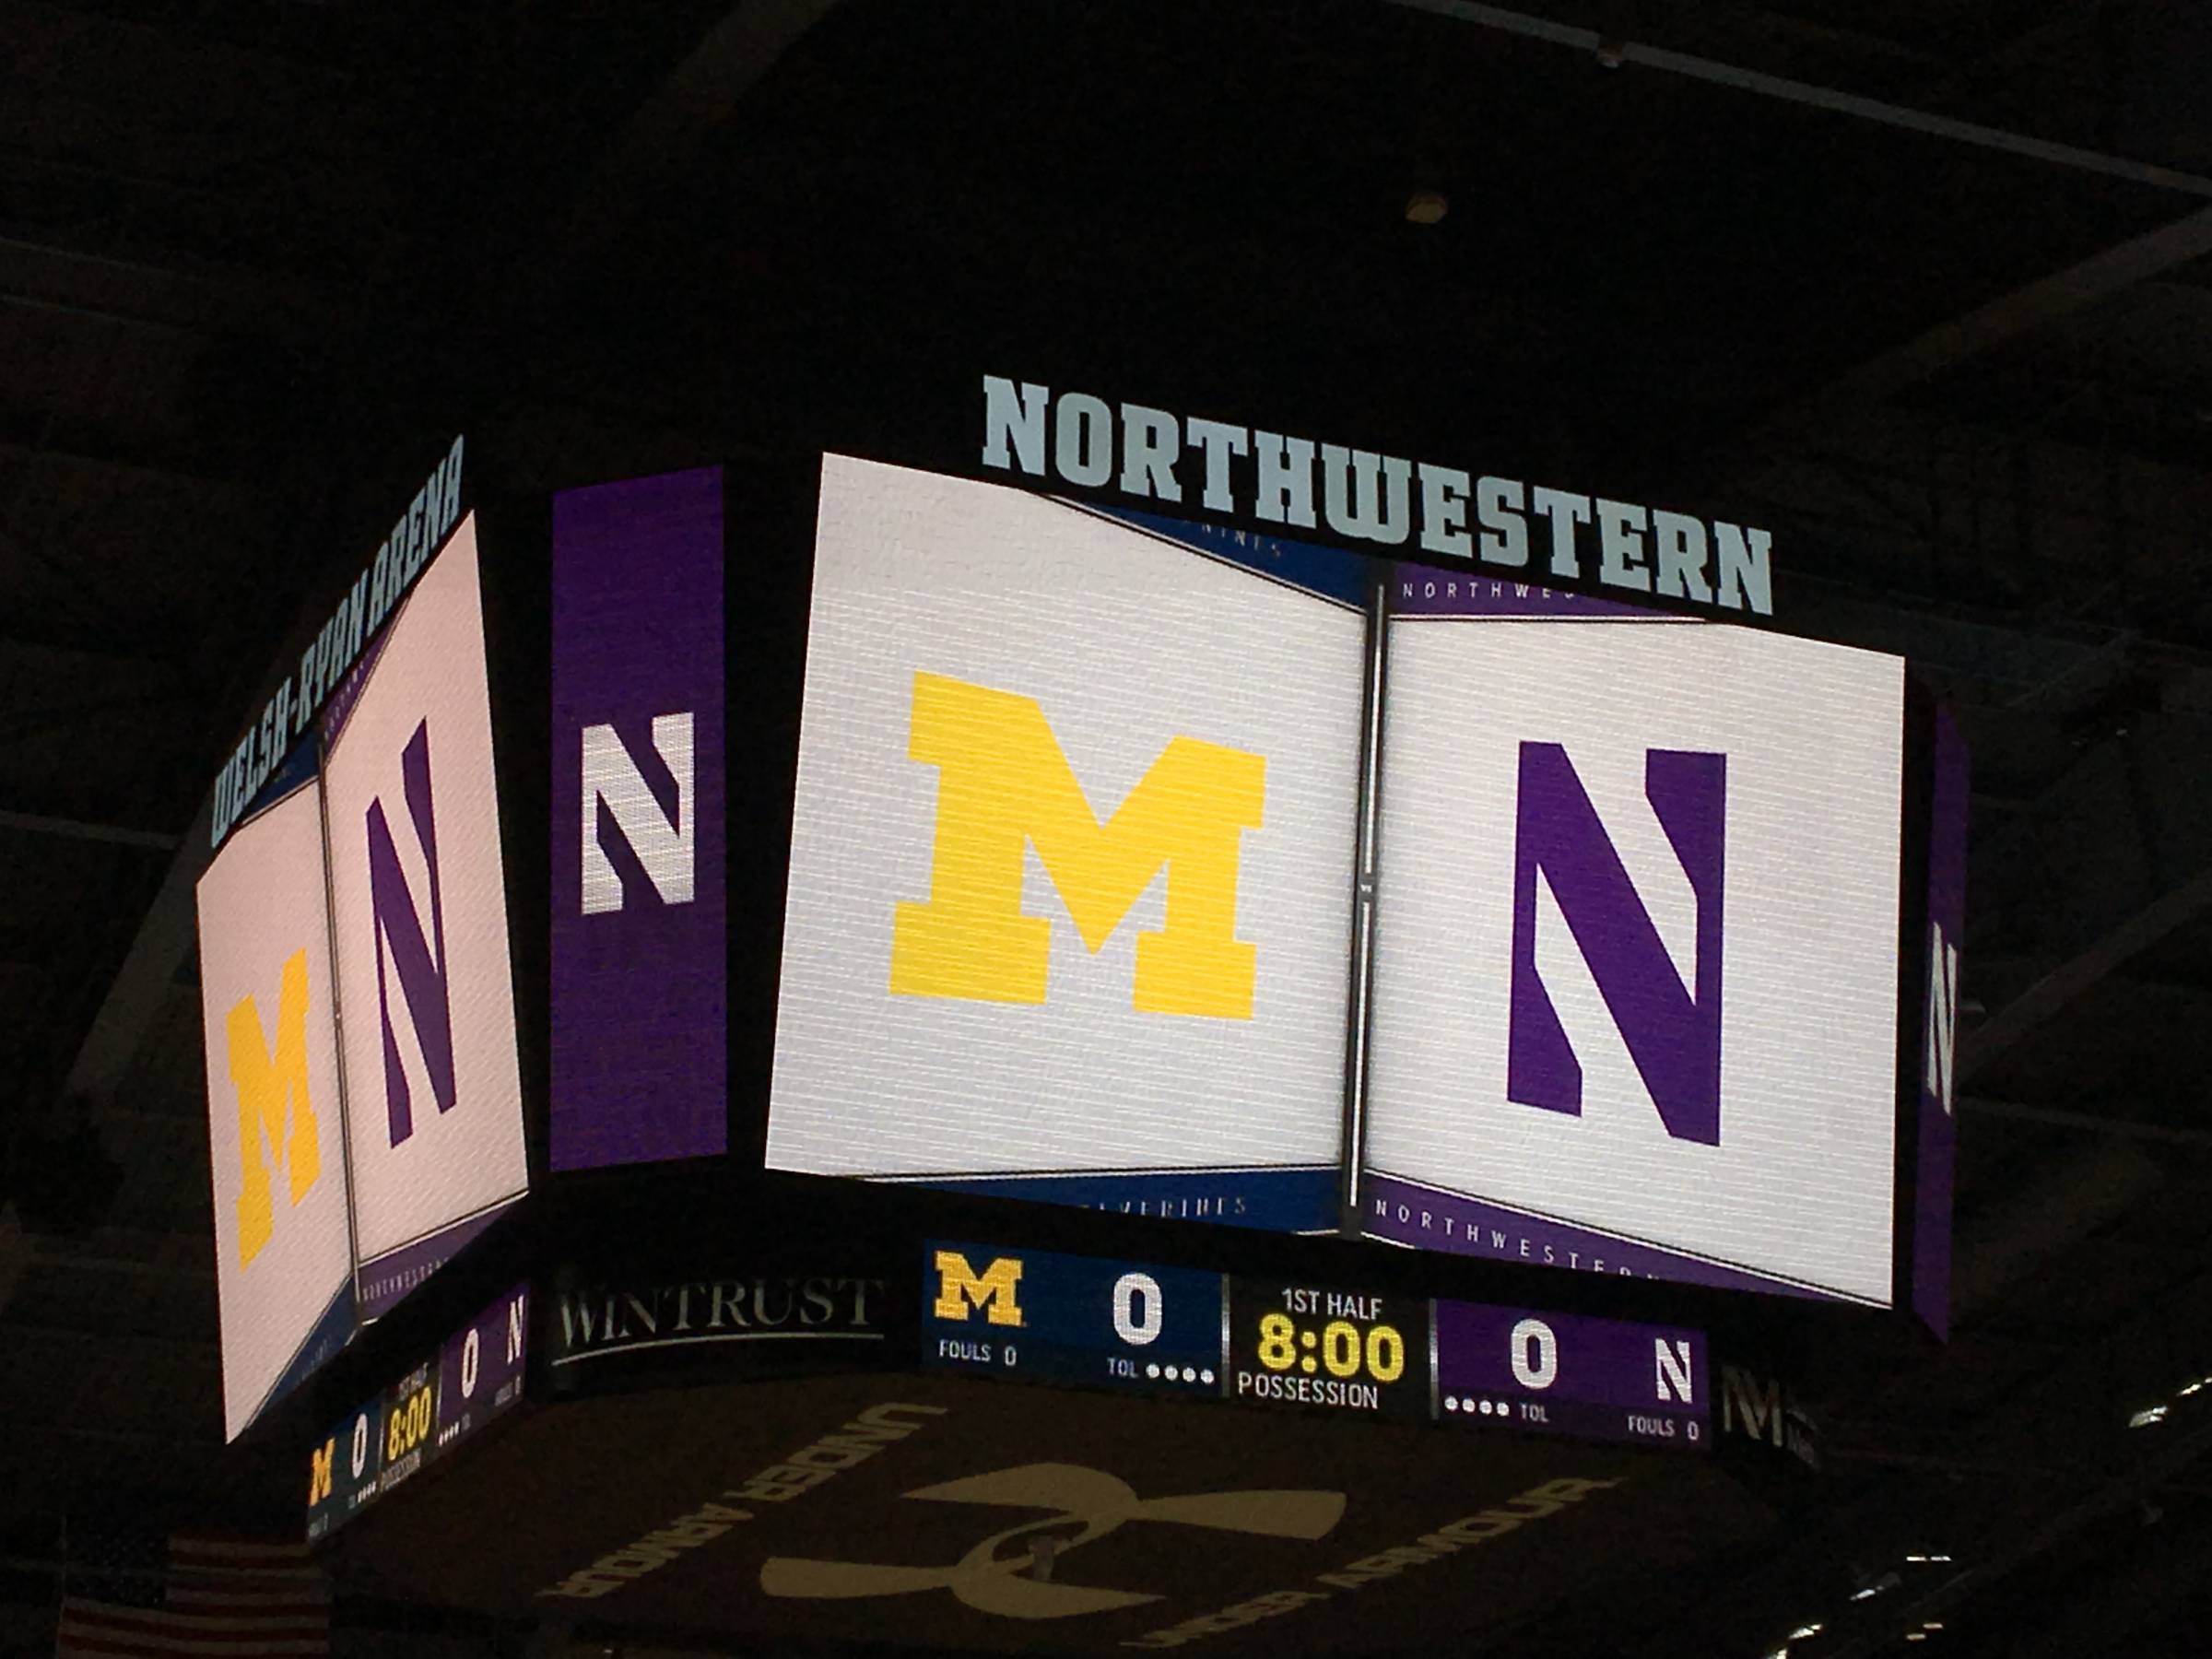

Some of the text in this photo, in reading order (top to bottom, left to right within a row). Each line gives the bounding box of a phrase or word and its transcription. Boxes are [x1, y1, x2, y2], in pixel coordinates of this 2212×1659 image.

[982, 374, 1773, 616] NORTHWESTERN
[211, 434, 464, 849] WELSH-RYAN ARENA
[582, 712, 695, 915] N
[888, 671, 1266, 1020] M
[366, 715, 457, 1149] N
[1506, 741, 1727, 1147] N
[1927, 921, 1958, 1116] N
[226, 948, 321, 1272] M
[559, 1277, 884, 1348] WINTRUST
[934, 1250, 1024, 1327] M
[1112, 1272, 1163, 1346] 0
[1282, 1288, 1383, 1321] 1ST HALF
[938, 1339, 992, 1363] FOULS
[1107, 1357, 1139, 1380] TOL
[1258, 1312, 1405, 1382] 8:00
[1511, 1318, 1558, 1390] 0
[1654, 1337, 1693, 1405] N
[387, 1385, 432, 1462] 8:00
[1238, 1371, 1379, 1410] POSSESSION
[1520, 1401, 1550, 1424] TOL
[1628, 1415, 1676, 1438] FOULS
[309, 1436, 335, 1508] M
[535, 1401, 948, 1599] UNDER ARMOUR
[1315, 1477, 1630, 1590] ARMOUR
